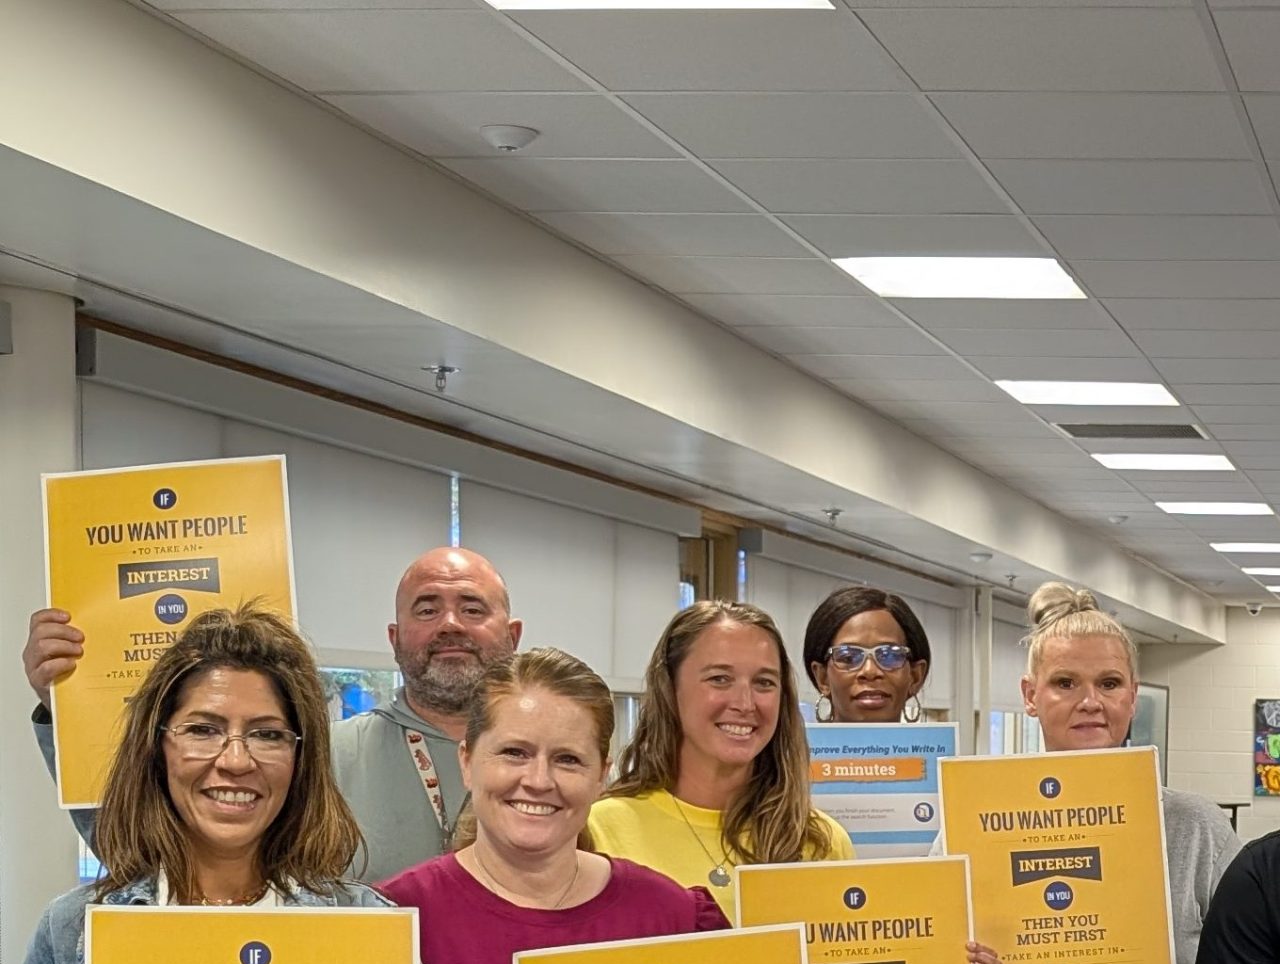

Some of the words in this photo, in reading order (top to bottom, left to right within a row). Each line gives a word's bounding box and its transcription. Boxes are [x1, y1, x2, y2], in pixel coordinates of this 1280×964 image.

[160, 494, 169, 506] IF
[86, 524, 123, 545] YOU
[127, 520, 178, 542] WANT
[182, 515, 247, 537] PEOPLE
[155, 545, 180, 554] TAKE
[183, 544, 197, 552] AN
[127, 568, 210, 585] INTEREST
[158, 606, 166, 614] IN
[168, 604, 184, 614] YOU
[130, 631, 177, 645] THEN
[842, 746, 889, 755] Everything
[892, 745, 908, 753] You
[911, 745, 934, 753] Write
[822, 764, 831, 776] 3
[835, 763, 896, 776] minutes
[1046, 782, 1054, 794] IF
[979, 812, 1014, 832] YOU
[1018, 809, 1064, 829] WANT
[1067, 805, 1126, 826] PEOPLE
[1068, 833, 1081, 841] AN
[1019, 856, 1093, 872] INTEREST
[850, 892, 859, 905] IF
[1047, 892, 1054, 901] IN
[1056, 891, 1071, 900] YOU
[1022, 917, 1064, 930] THEN
[1067, 914, 1099, 926] YOU
[819, 921, 868, 942] WANT
[872, 917, 934, 940] PEOPLE
[1017, 932, 1060, 946] MUST
[1064, 929, 1107, 942] FIRST
[249, 949, 261, 964] IF
[845, 948, 869, 956] TAKE
[1006, 953, 1032, 961] TAKE
[1054, 948, 1104, 958] INTEREST
